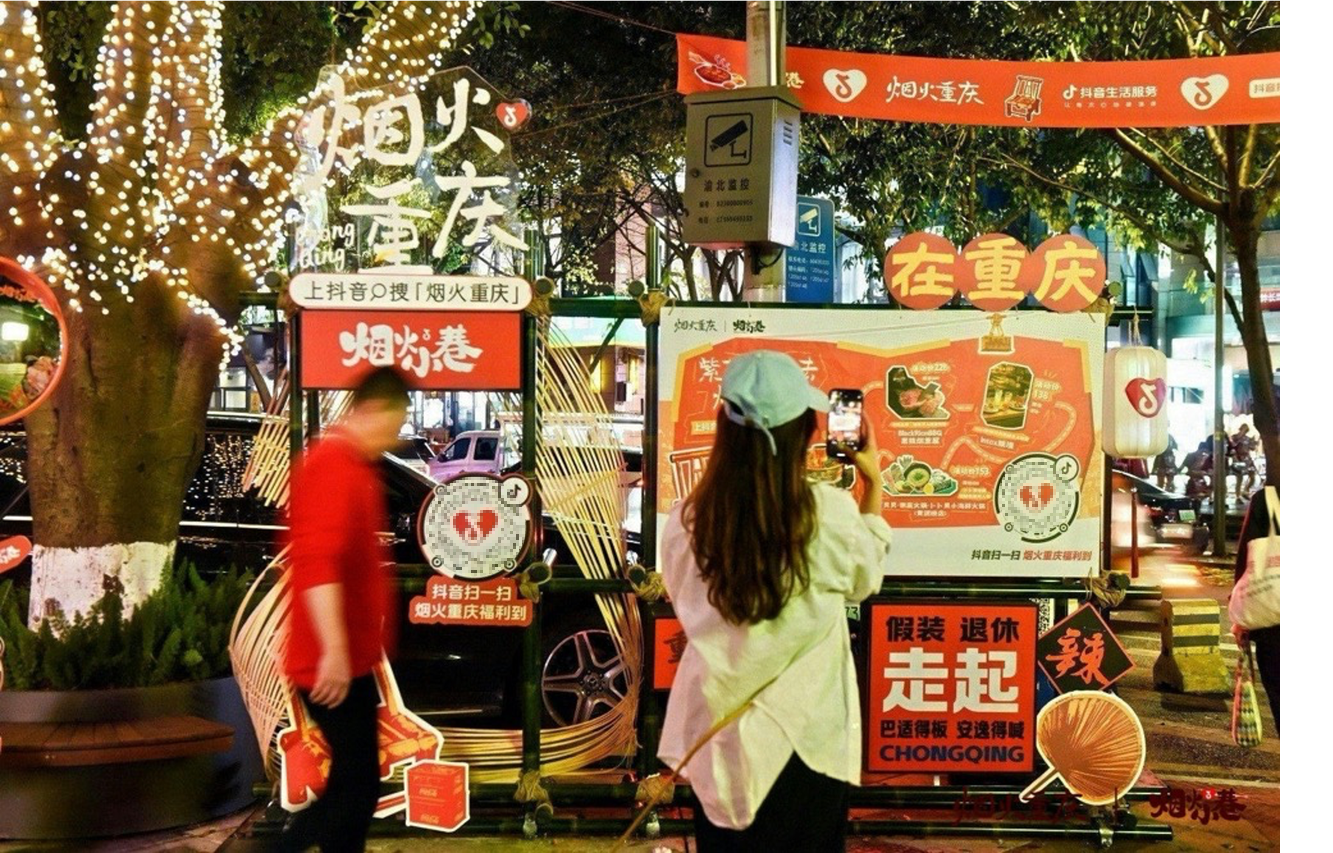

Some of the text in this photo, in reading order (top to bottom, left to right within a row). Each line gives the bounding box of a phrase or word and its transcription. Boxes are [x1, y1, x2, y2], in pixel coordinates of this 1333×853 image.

[885, 77, 984, 106] 烟火重庆
[1080, 86, 1157, 98] 抖音生活服务
[303, 75, 505, 178] 烟火
[342, 162, 529, 274] 重庆
[891, 237, 1099, 304] 在重庆
[971, 550, 1092, 561] 抖音扫一扫 烟火重庆福利到
[432, 584, 512, 601] 抖音扫一扫
[414, 603, 527, 622] 烟火重庆福利到
[886, 615, 1020, 644] 假装 退休
[1045, 627, 1105, 685] 辣
[883, 648, 1020, 715] 走起
[880, 720, 1024, 740] 巴适得板 安逸得喊
[880, 745, 1024, 765] CHONGQING
